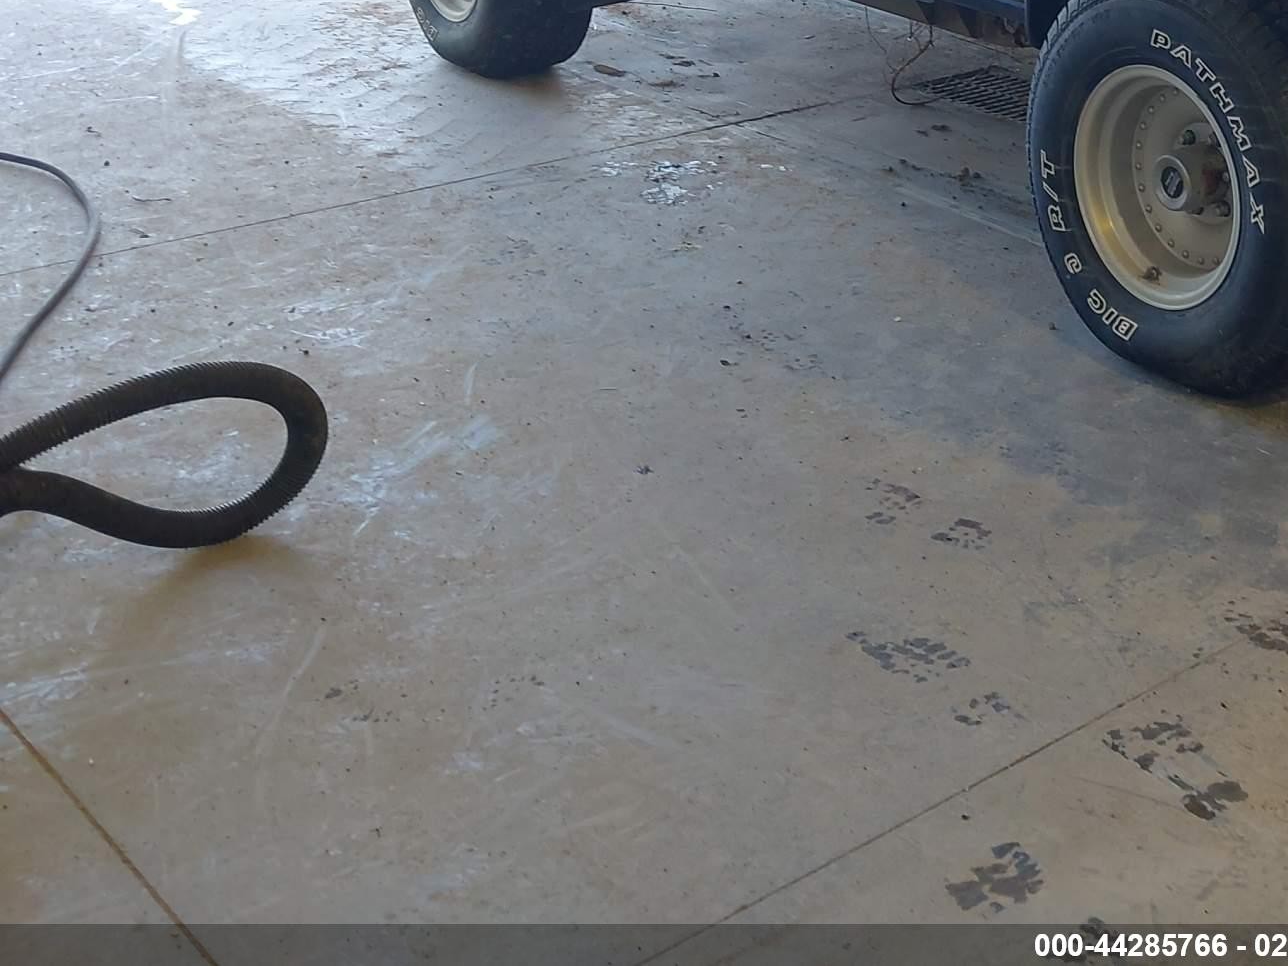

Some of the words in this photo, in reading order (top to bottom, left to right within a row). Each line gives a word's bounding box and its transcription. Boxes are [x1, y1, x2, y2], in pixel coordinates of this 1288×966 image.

[1150, 29, 1265, 234] PATHMAX
[1040, 149, 1066, 232] R/T
[1087, 288, 1138, 341] BIG
